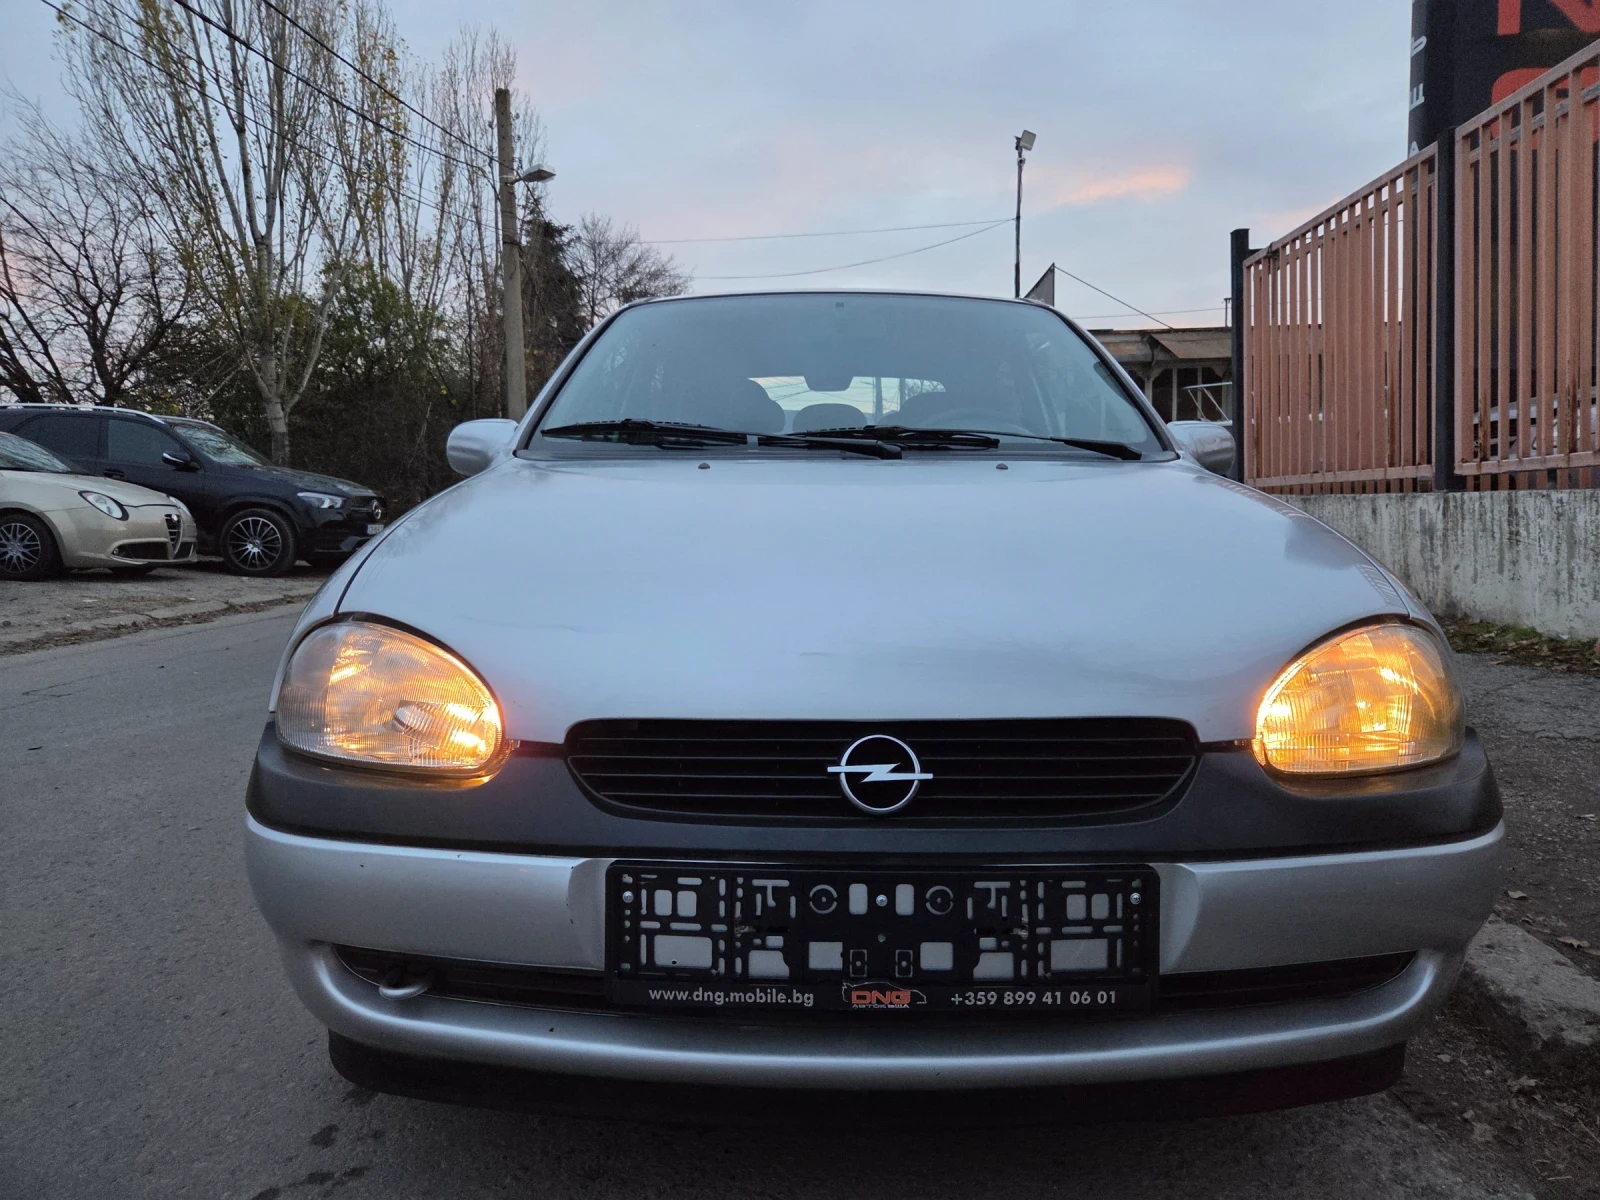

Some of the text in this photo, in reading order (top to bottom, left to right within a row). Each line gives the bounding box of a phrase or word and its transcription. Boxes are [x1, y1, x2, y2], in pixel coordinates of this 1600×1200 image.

[649, 987, 814, 1007] www.dng.mobile.bg
[851, 990, 911, 1004] DNG
[951, 991, 1116, 1005] +359 899 41 06 01
